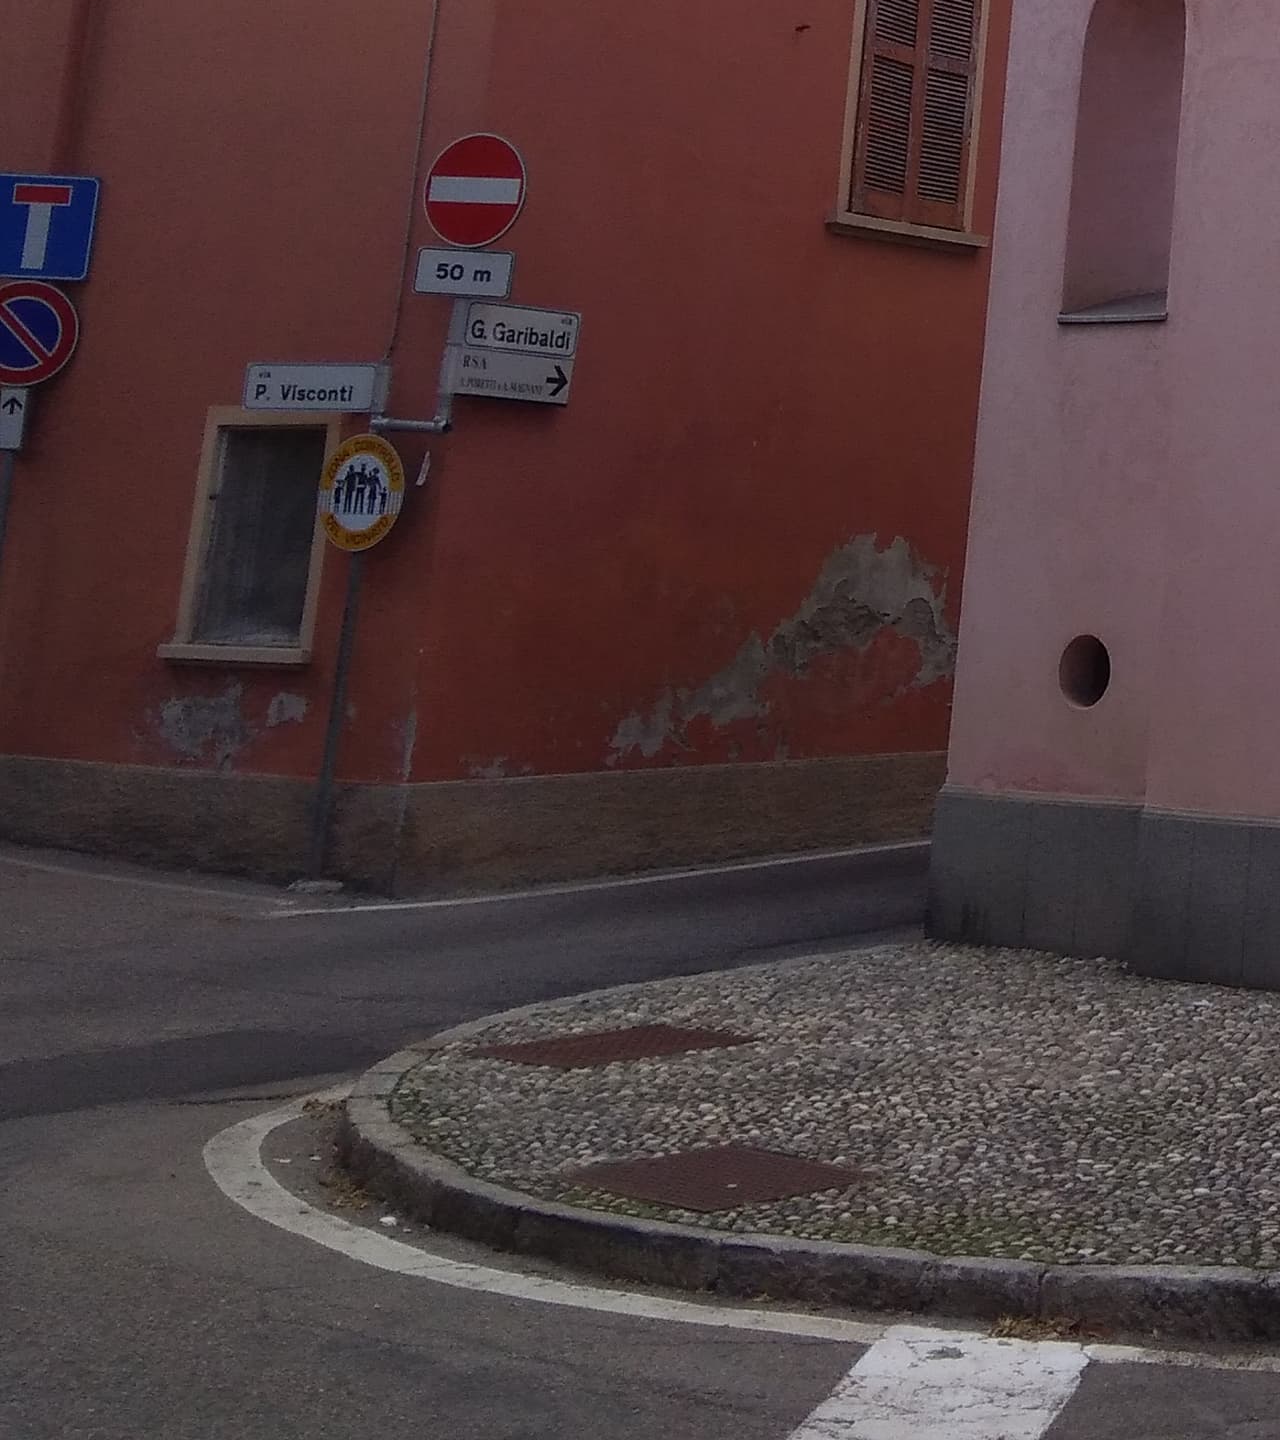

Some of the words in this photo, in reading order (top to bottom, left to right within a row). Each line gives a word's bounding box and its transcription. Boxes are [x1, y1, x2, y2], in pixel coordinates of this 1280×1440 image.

[436, 262, 465, 281] 50
[473, 268, 492, 282] m
[471, 319, 487, 340] G.
[493, 322, 572, 351] Garibaldi
[462, 354, 487, 371] RSA
[258, 370, 272, 379] via
[255, 383, 271, 401] P.
[280, 384, 354, 402] Visconti
